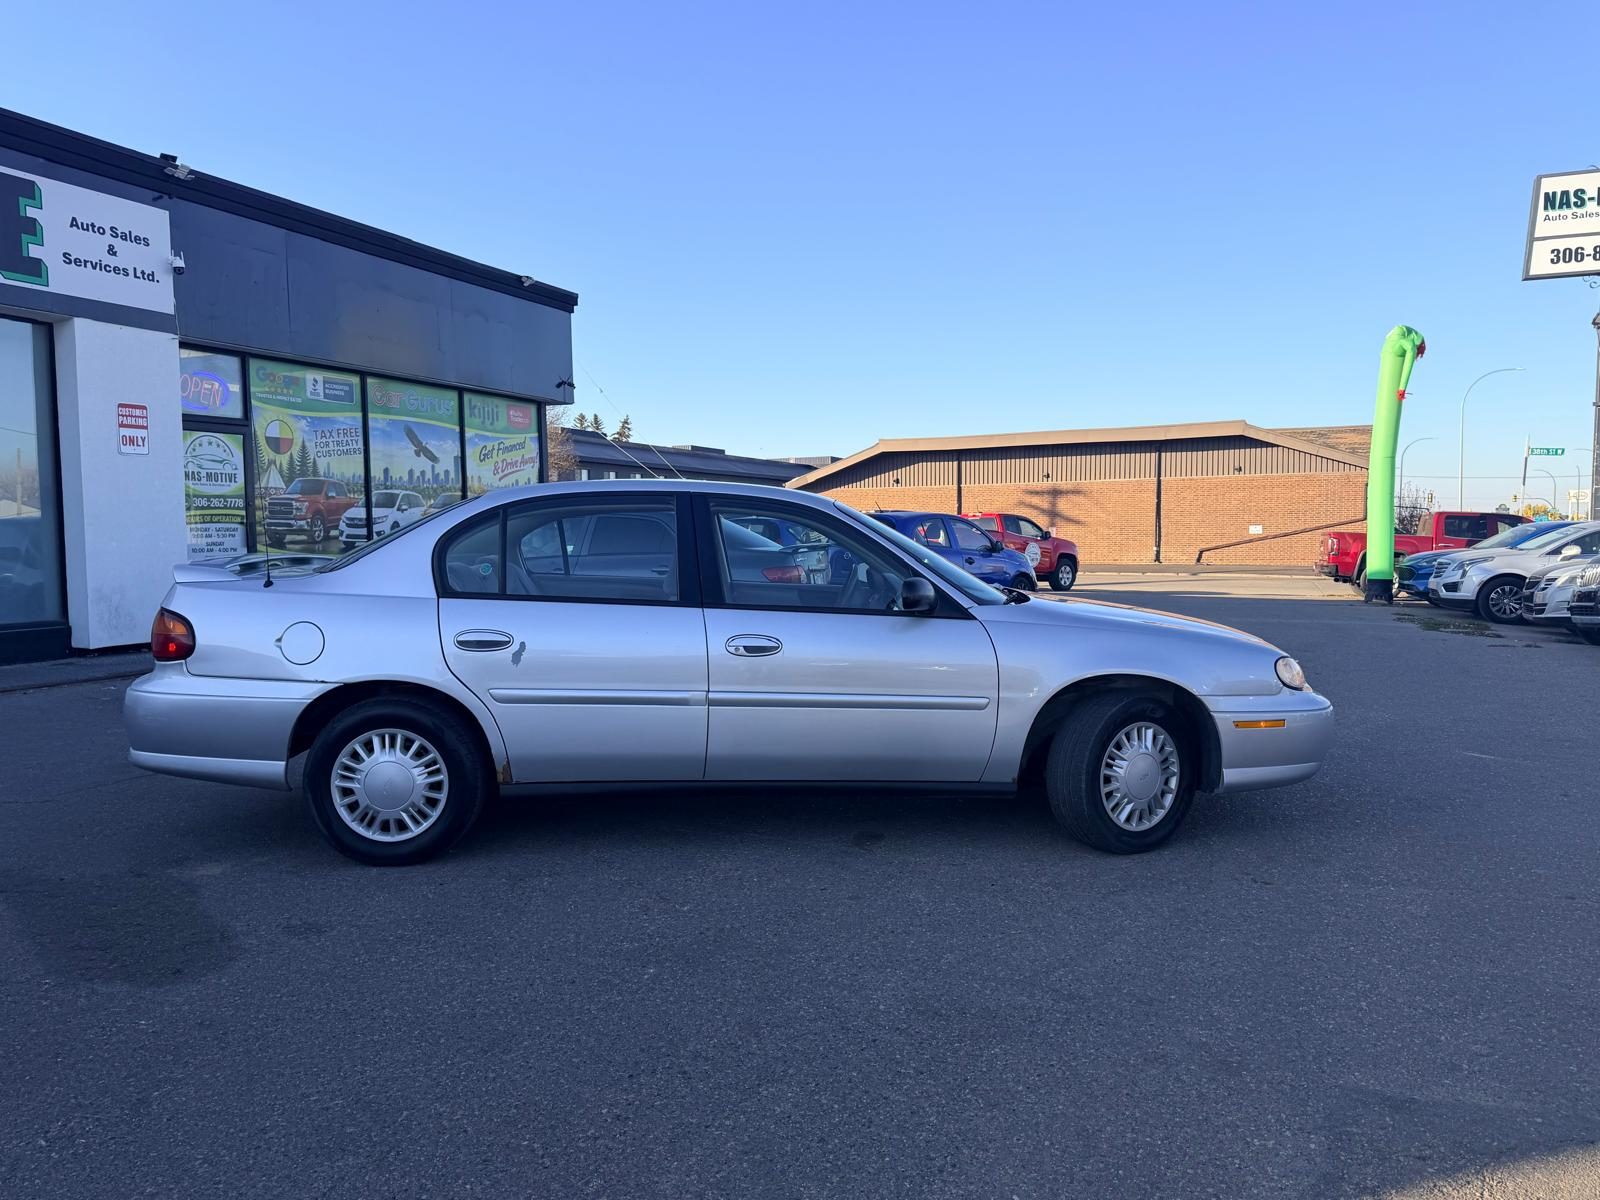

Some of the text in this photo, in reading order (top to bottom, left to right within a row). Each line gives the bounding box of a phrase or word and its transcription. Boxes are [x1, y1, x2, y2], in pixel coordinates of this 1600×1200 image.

[1543, 187, 1600, 212] NAS-
[1543, 210, 1600, 222] Auto Sales
[69, 216, 150, 247] Auto Sales
[107, 243, 118, 257] &
[62, 251, 160, 283] Services Ltd.
[180, 374, 223, 408] OPEN
[119, 407, 147, 417] CUSTOMER
[119, 416, 147, 426] PARKING
[313, 427, 360, 440] TAX FREE
[121, 434, 146, 447] ONLY
[315, 439, 359, 449] FOR TREATY
[316, 448, 362, 458] CUSTOMERS
[479, 436, 526, 463] Get Financed
[493, 460, 500, 476] &
[501, 458, 519, 473] Drive
[184, 470, 238, 483] NAS-MOTIVE
[192, 498, 244, 507] 306-262-7778
